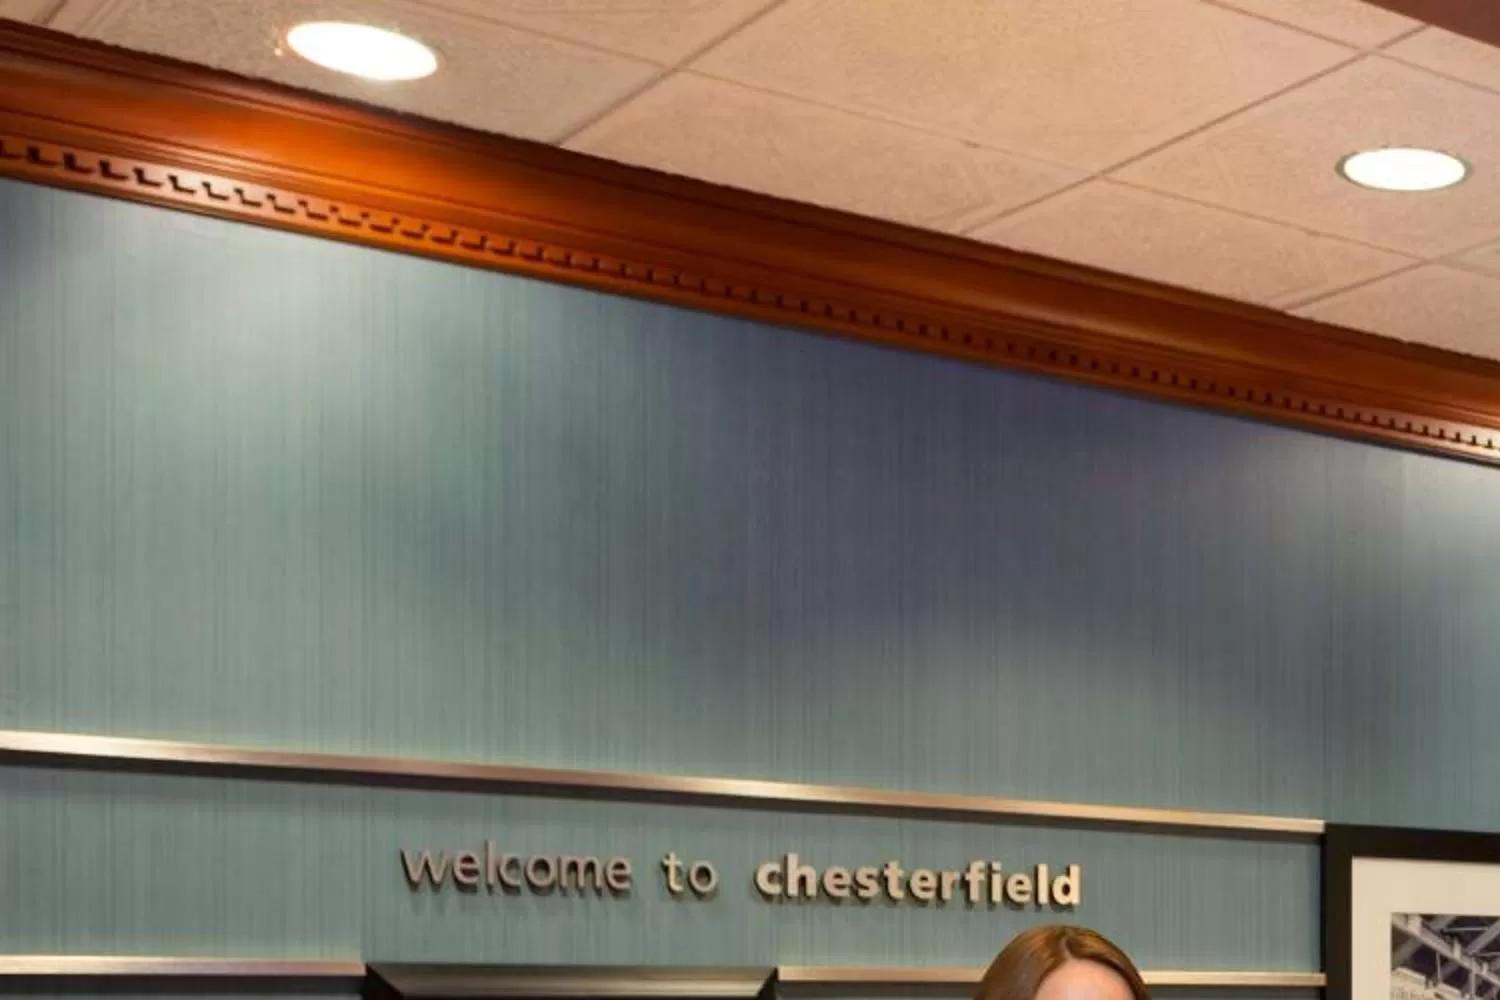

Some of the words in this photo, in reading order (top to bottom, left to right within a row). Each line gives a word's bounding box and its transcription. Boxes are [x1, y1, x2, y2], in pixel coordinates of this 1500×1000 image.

[400, 840, 633, 893] welcome
[661, 851, 718, 895] to
[754, 853, 1081, 906] chesterfield
